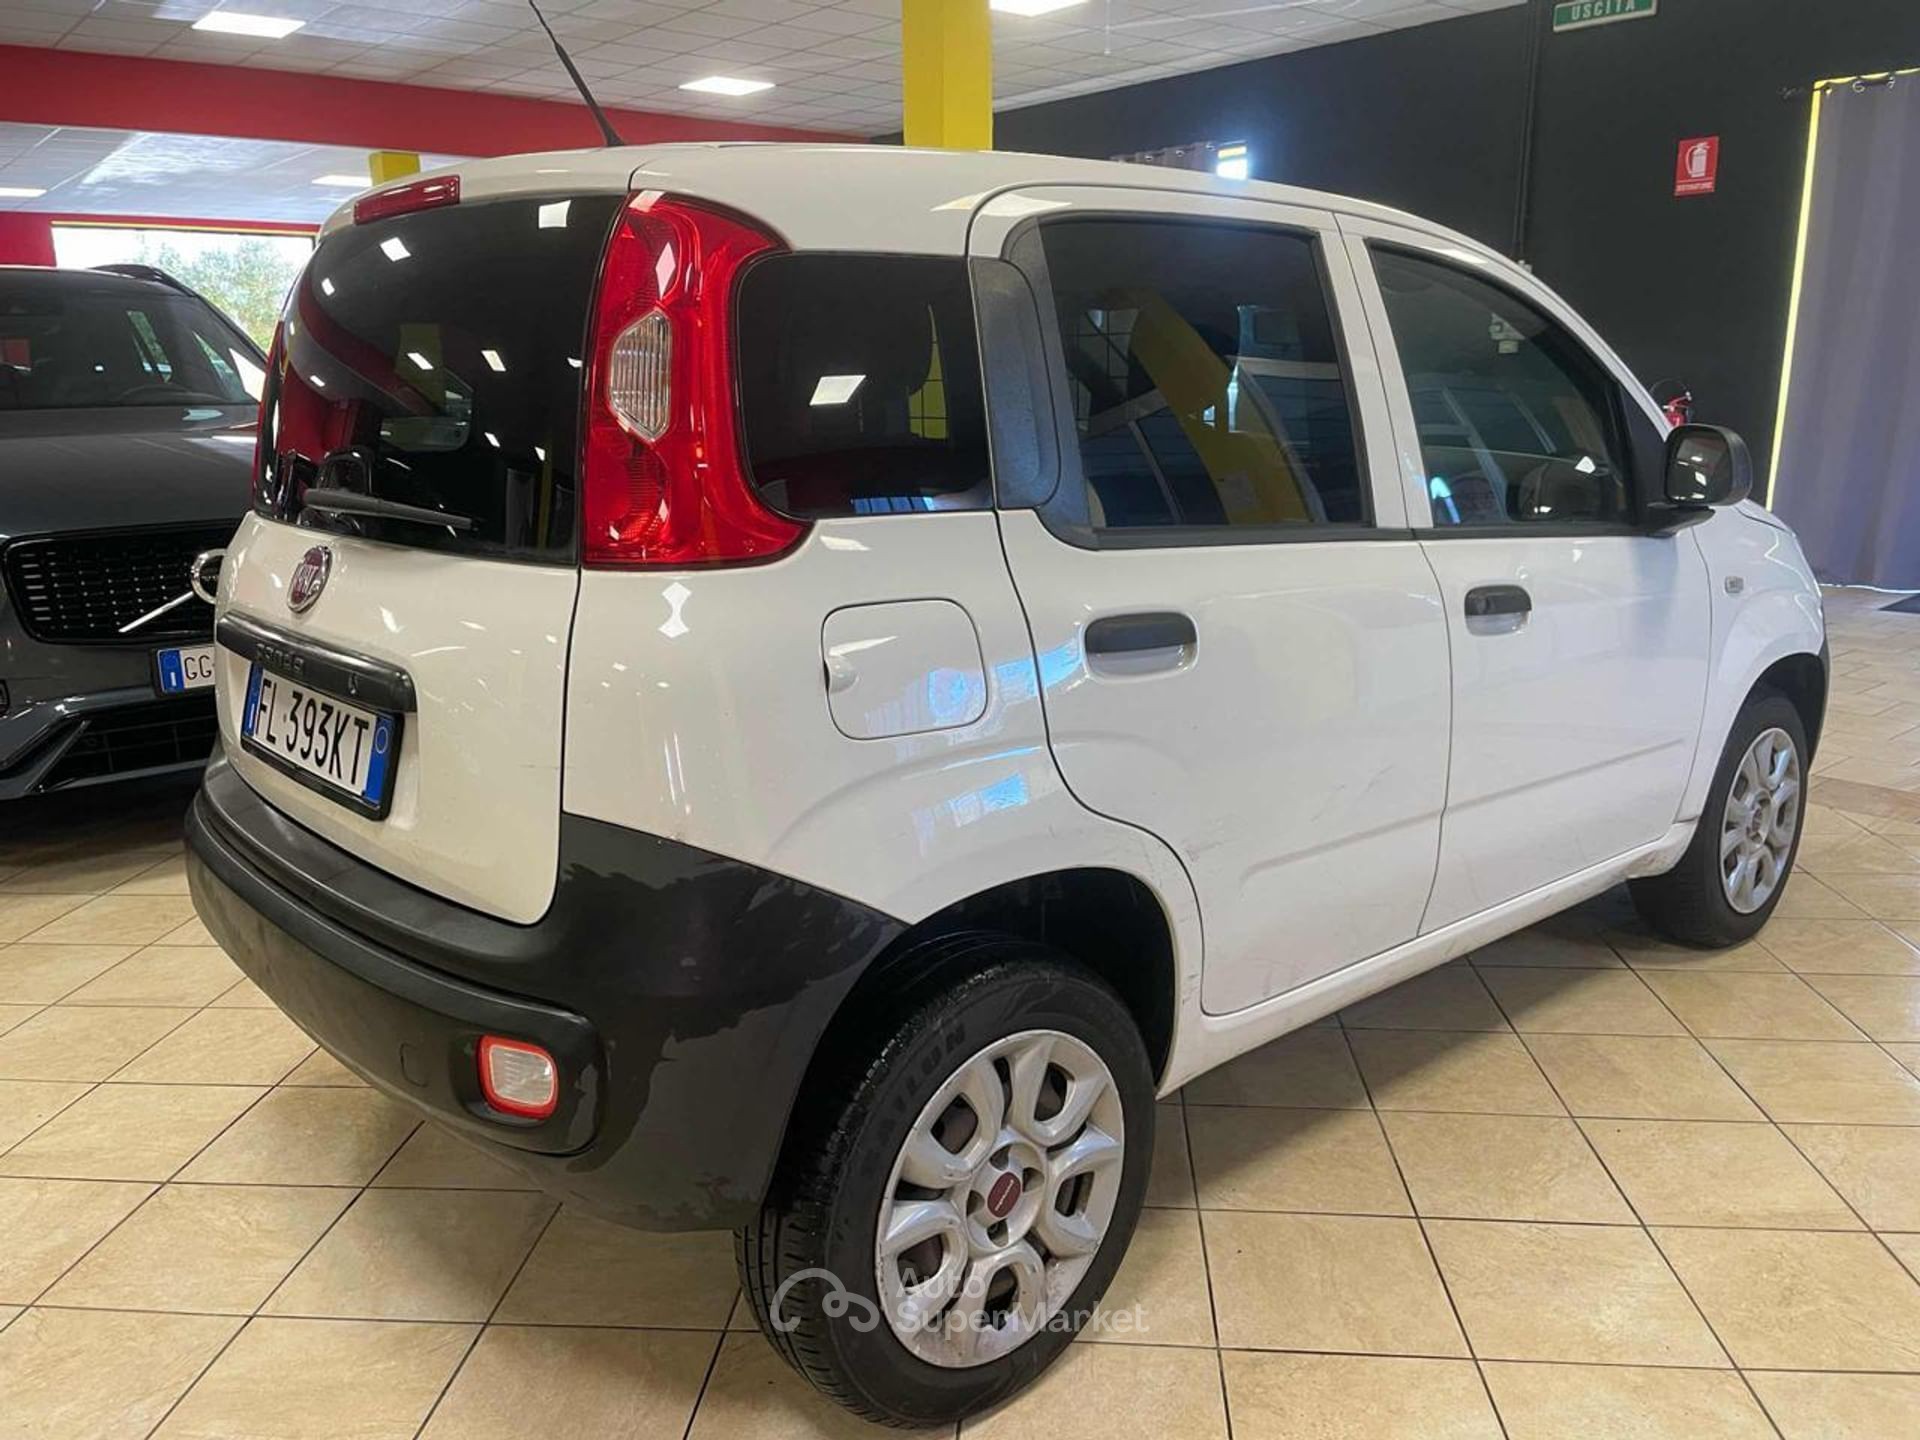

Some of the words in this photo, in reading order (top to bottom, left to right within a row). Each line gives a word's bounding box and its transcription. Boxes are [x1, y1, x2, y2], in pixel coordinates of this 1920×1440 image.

[1571, 0, 1635, 20] USCITA
[184, 655, 213, 681] GG
[286, 691, 369, 785] 393KT
